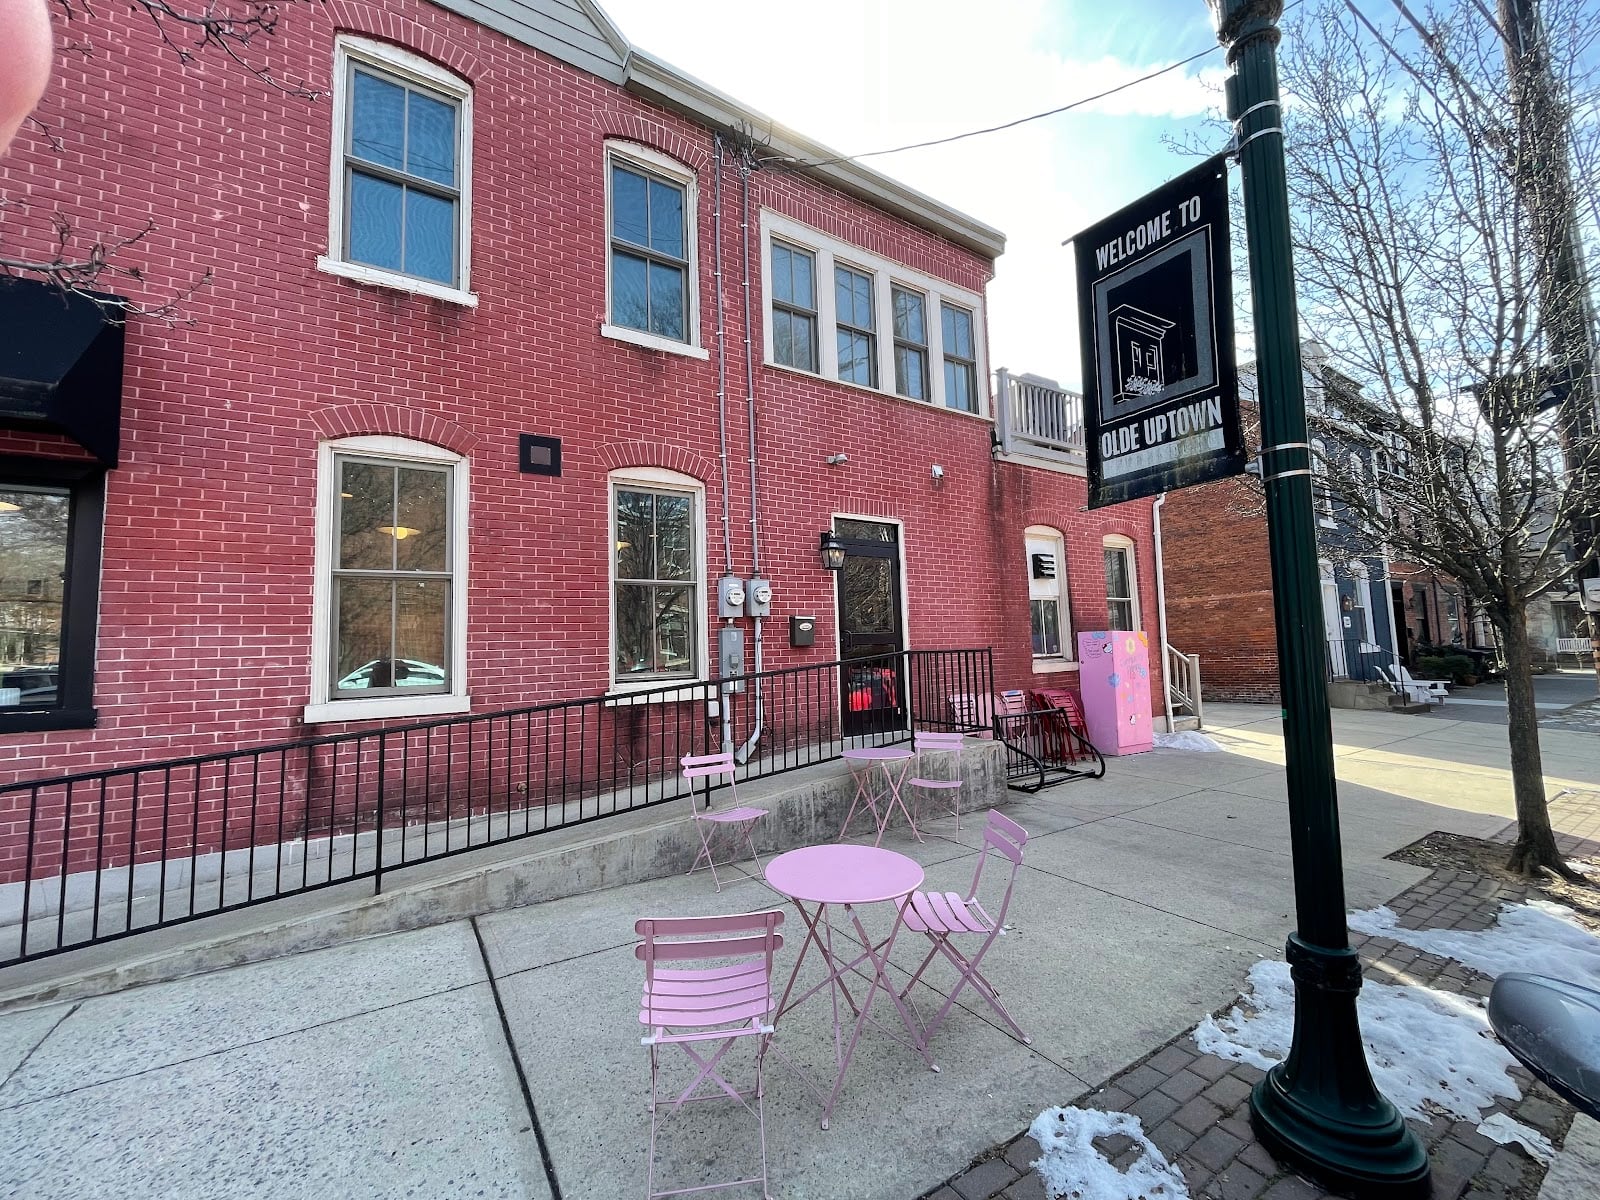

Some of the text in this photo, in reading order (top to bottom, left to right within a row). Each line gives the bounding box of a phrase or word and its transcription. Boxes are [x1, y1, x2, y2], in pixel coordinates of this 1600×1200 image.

[1096, 195, 1201, 271] WELCOME TO
[1101, 423, 1140, 458] OLDE
[1144, 396, 1223, 446] UPTOWN
